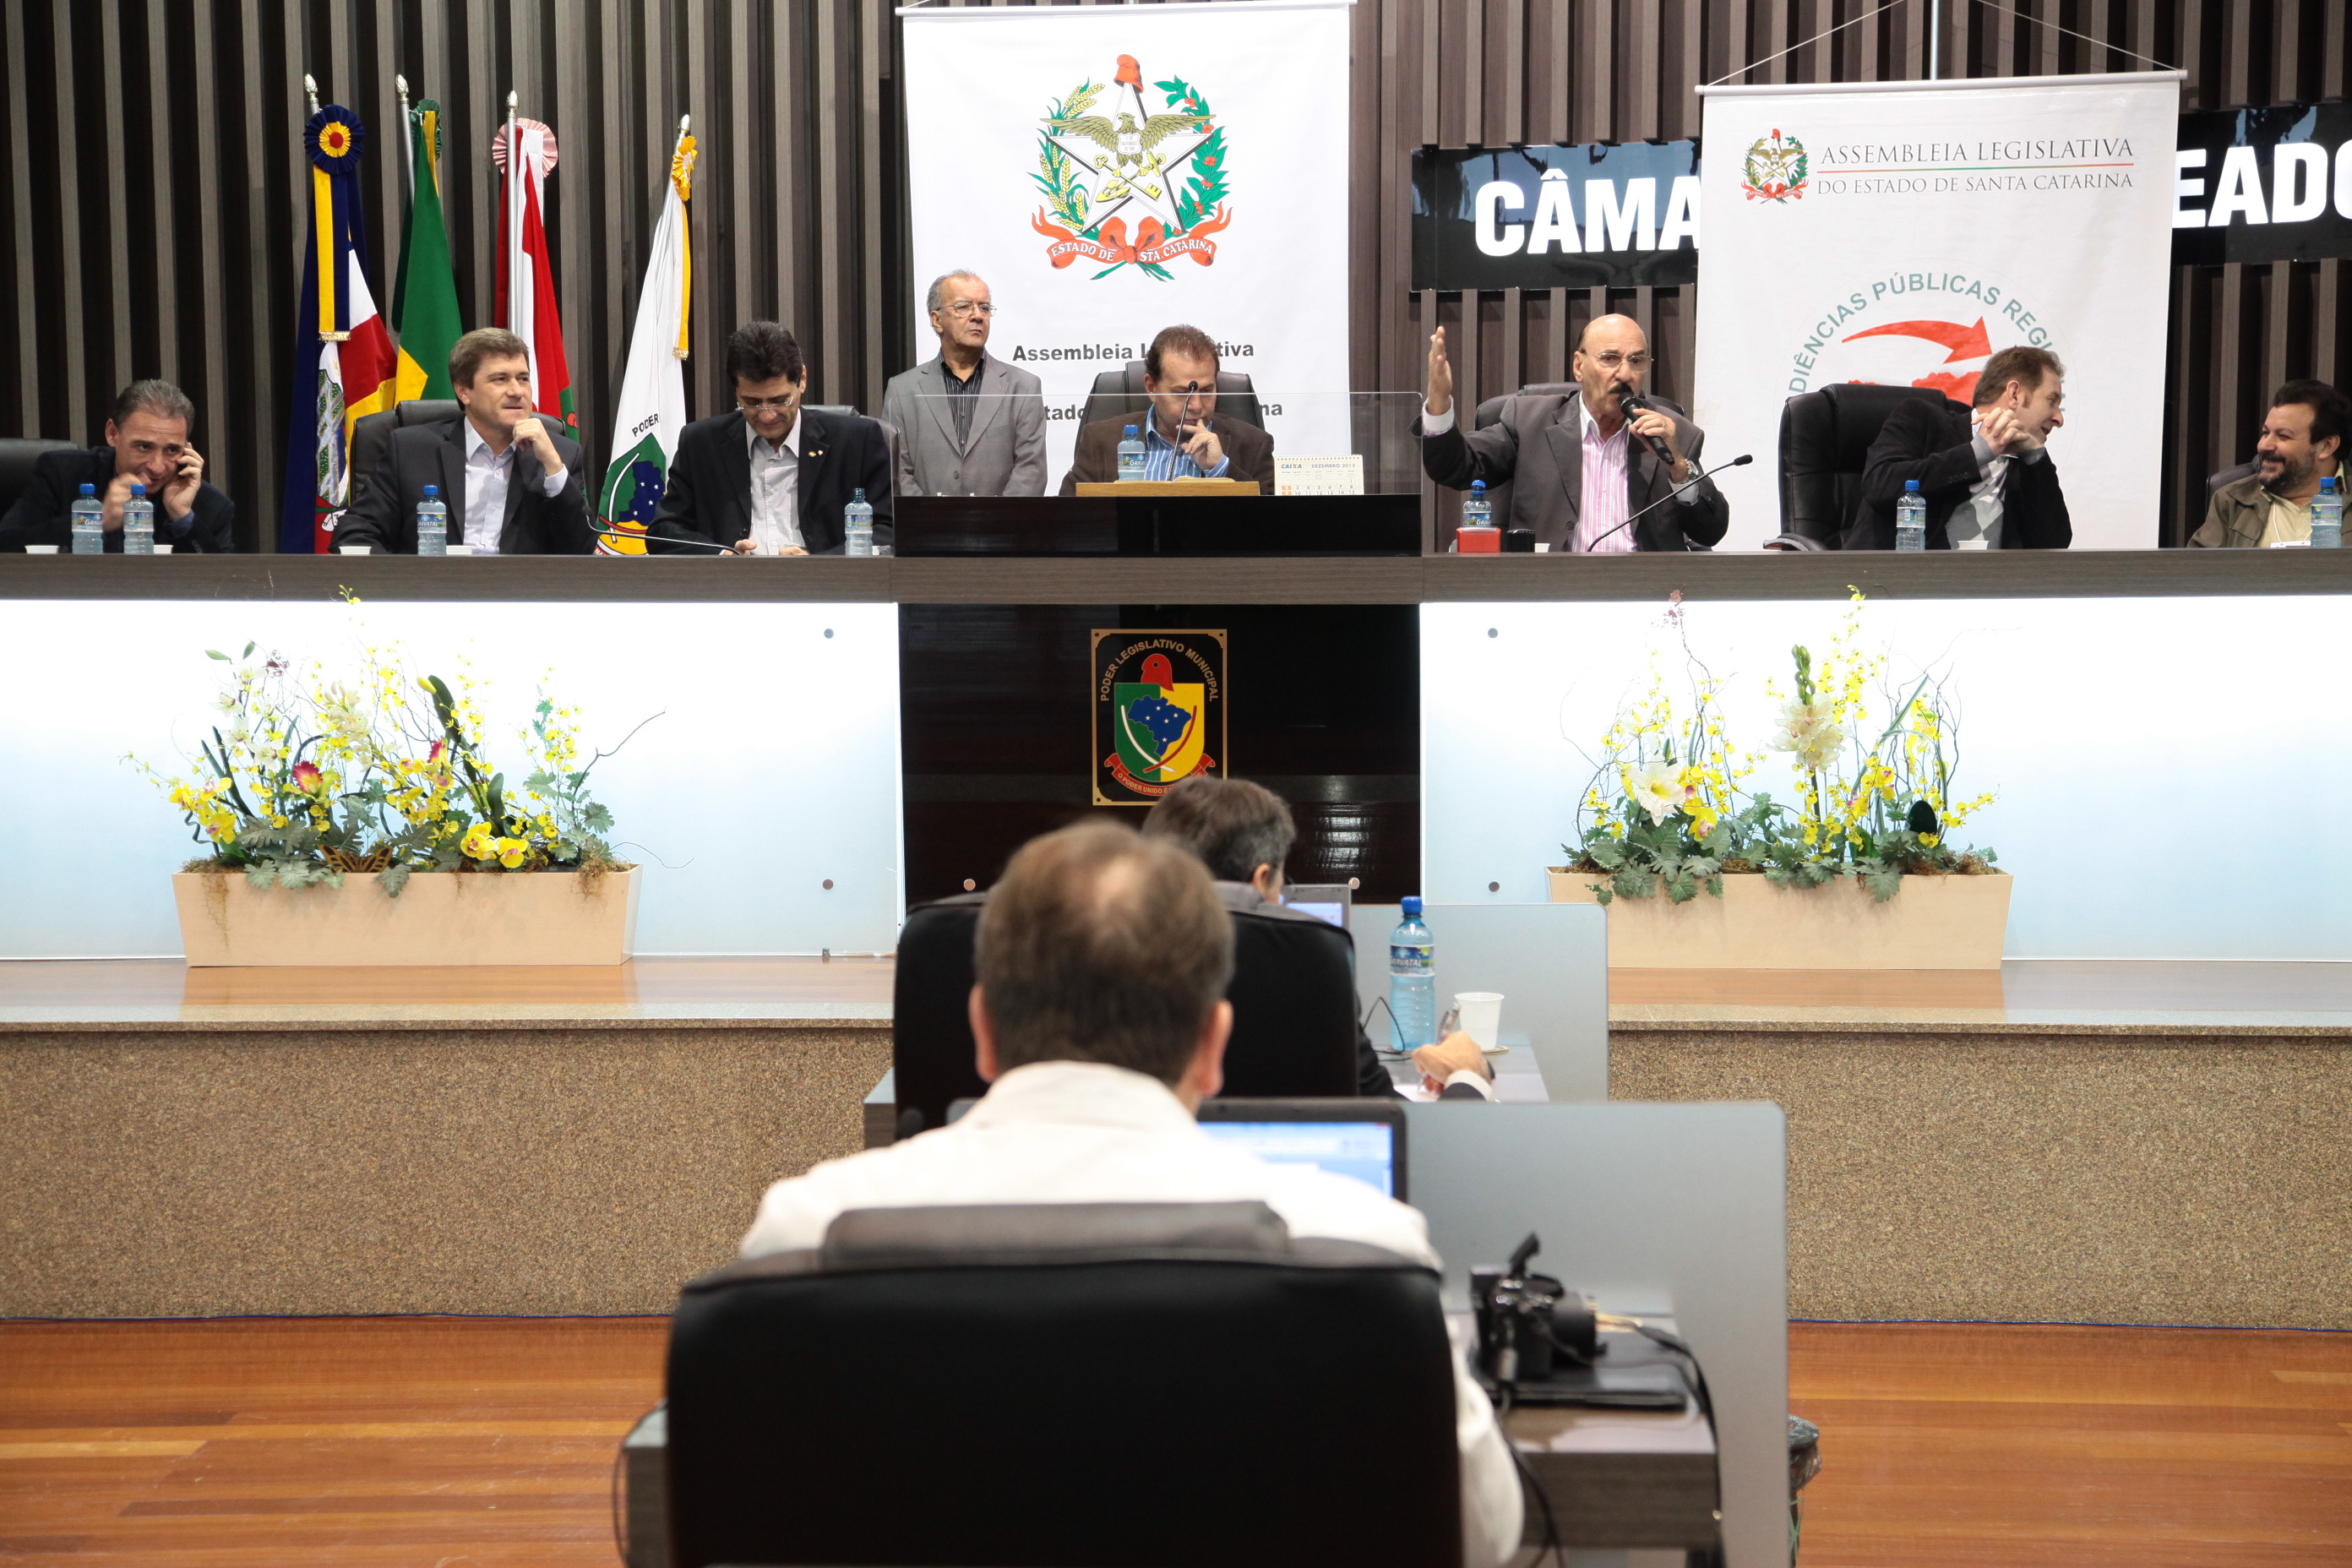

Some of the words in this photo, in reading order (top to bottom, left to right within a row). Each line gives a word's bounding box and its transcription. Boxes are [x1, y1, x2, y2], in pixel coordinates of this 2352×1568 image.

[1821, 142, 1968, 164] ASSEMBLEIA
[1978, 138, 2134, 161] LEGISLATIVA
[1818, 179, 1847, 194] DO
[1854, 177, 1927, 193] ESTADO
[1935, 177, 1958, 192] DE
[1966, 176, 2028, 192] SANTA
[2034, 172, 2133, 190] CATARINA
[1475, 168, 1701, 257] CÂMA
[1050, 242, 1097, 257] ESTADO
[1098, 248, 1114, 262] DE
[1163, 239, 1213, 258] CATARINA
[1788, 292, 1867, 393] DIÊNCIAS
[1871, 271, 2001, 306] PÚBLICAS
[1012, 344, 1133, 362] Assembleia
[632, 413, 659, 438] PODER
[1100, 663, 1119, 701] PODER
[1115, 639, 1184, 665] LEGISLATIVO
[1185, 648, 1218, 702] MUNICIPAL
[1122, 776, 1142, 792] PODER
